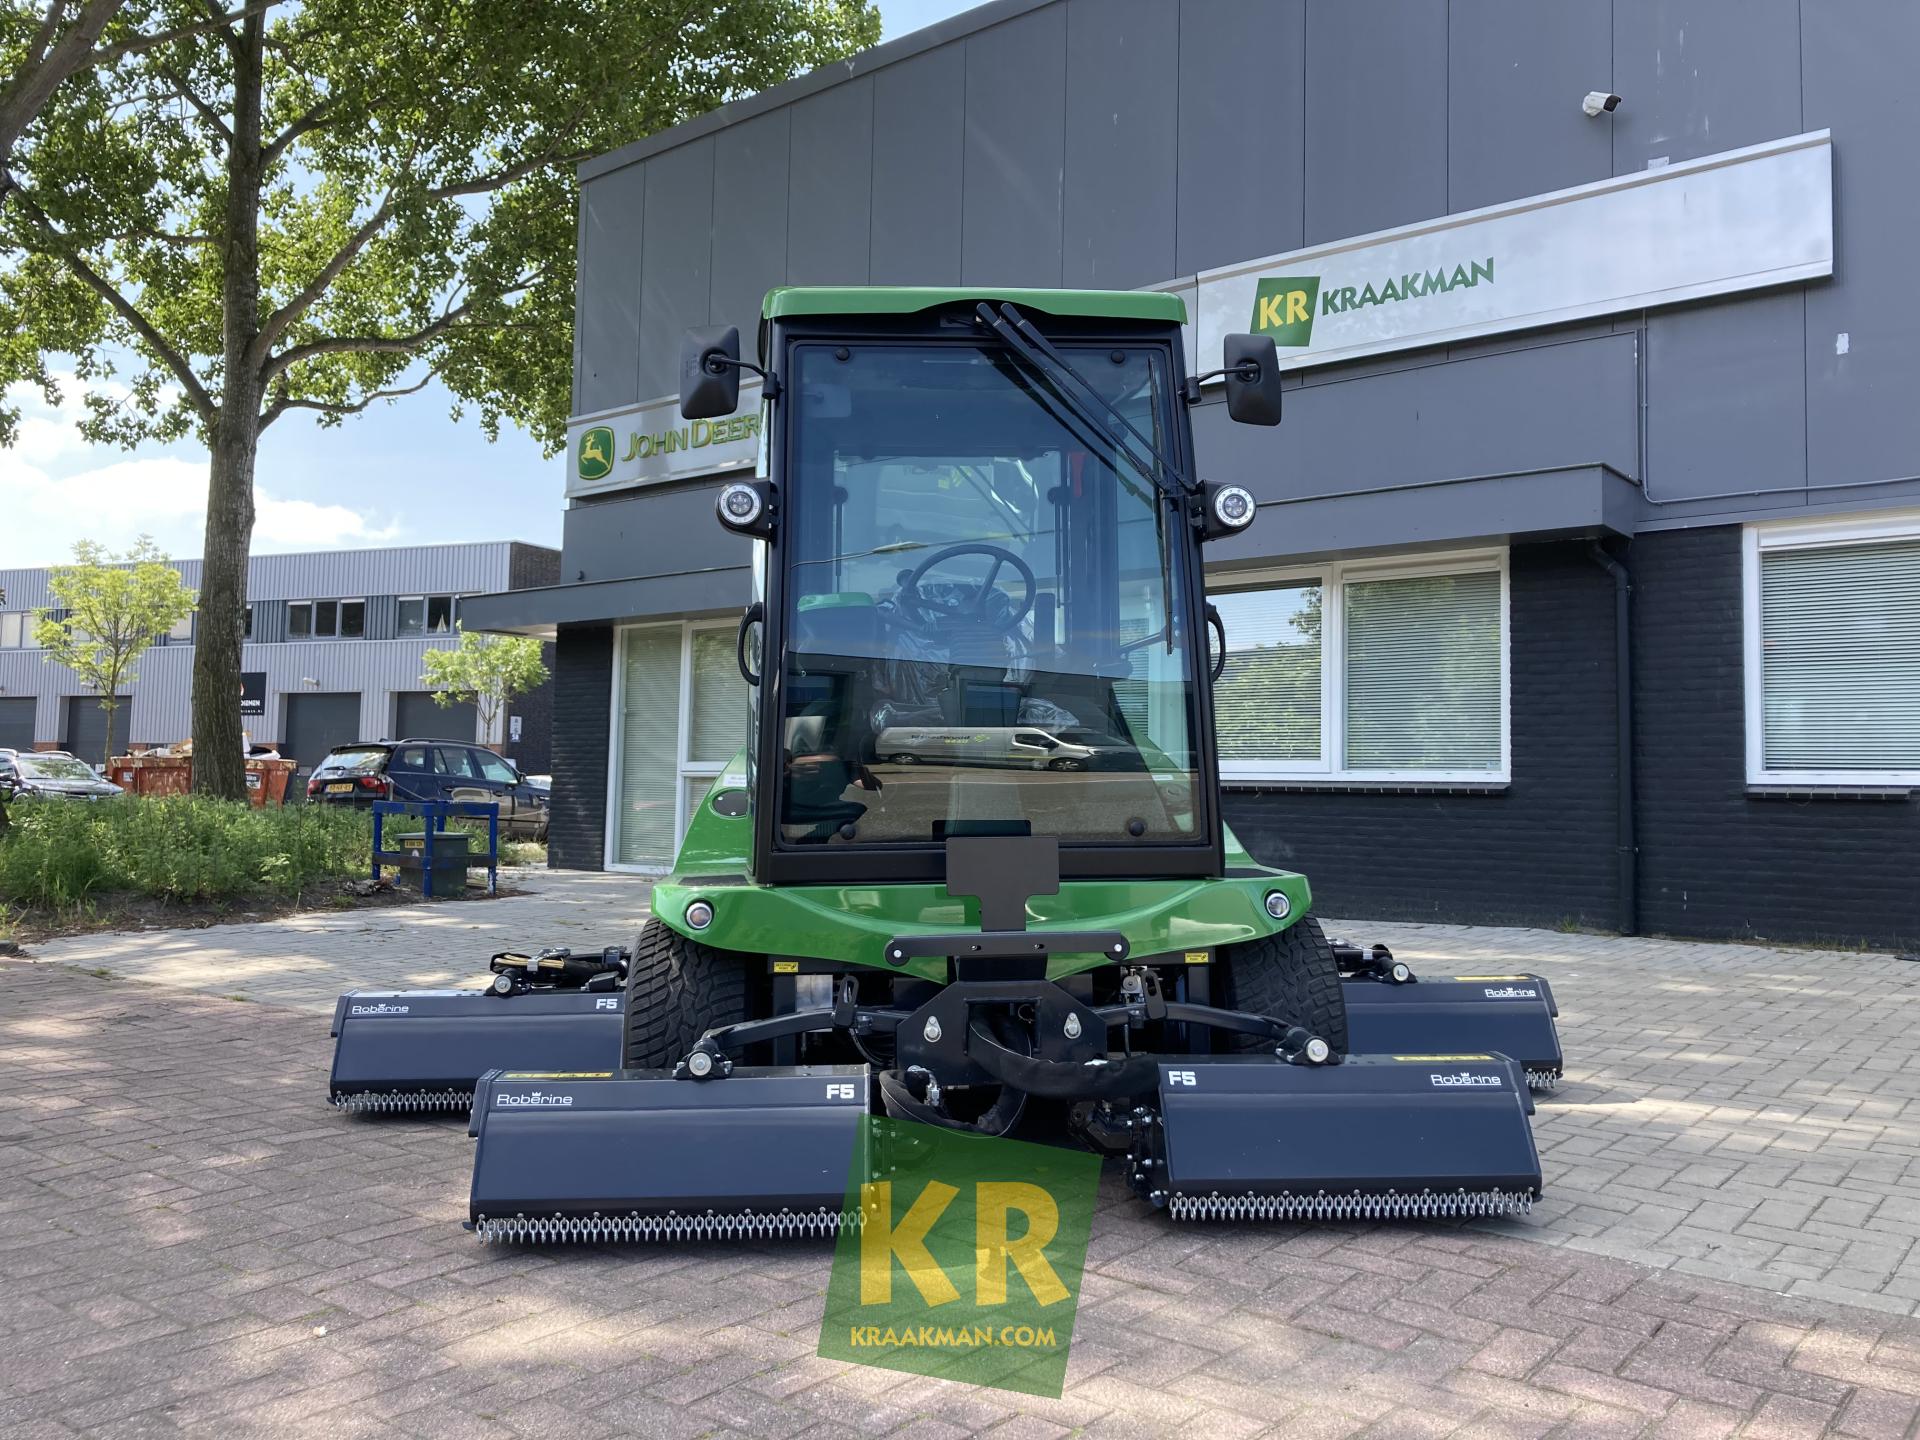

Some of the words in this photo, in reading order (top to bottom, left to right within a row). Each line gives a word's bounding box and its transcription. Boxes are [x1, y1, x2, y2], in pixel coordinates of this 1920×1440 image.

[1259, 289, 1310, 331] KR
[1322, 256, 1494, 316] KRAAKMAN
[622, 426, 688, 462] JOHN
[691, 414, 760, 449] DEER
[1485, 988, 1537, 997] Roberine
[351, 1004, 409, 1014] Roberine
[595, 998, 618, 1009] F5
[1168, 1070, 1197, 1086] F5
[1430, 1074, 1502, 1085] Roberine
[826, 1083, 855, 1100] F5
[496, 1093, 573, 1106] Roberine
